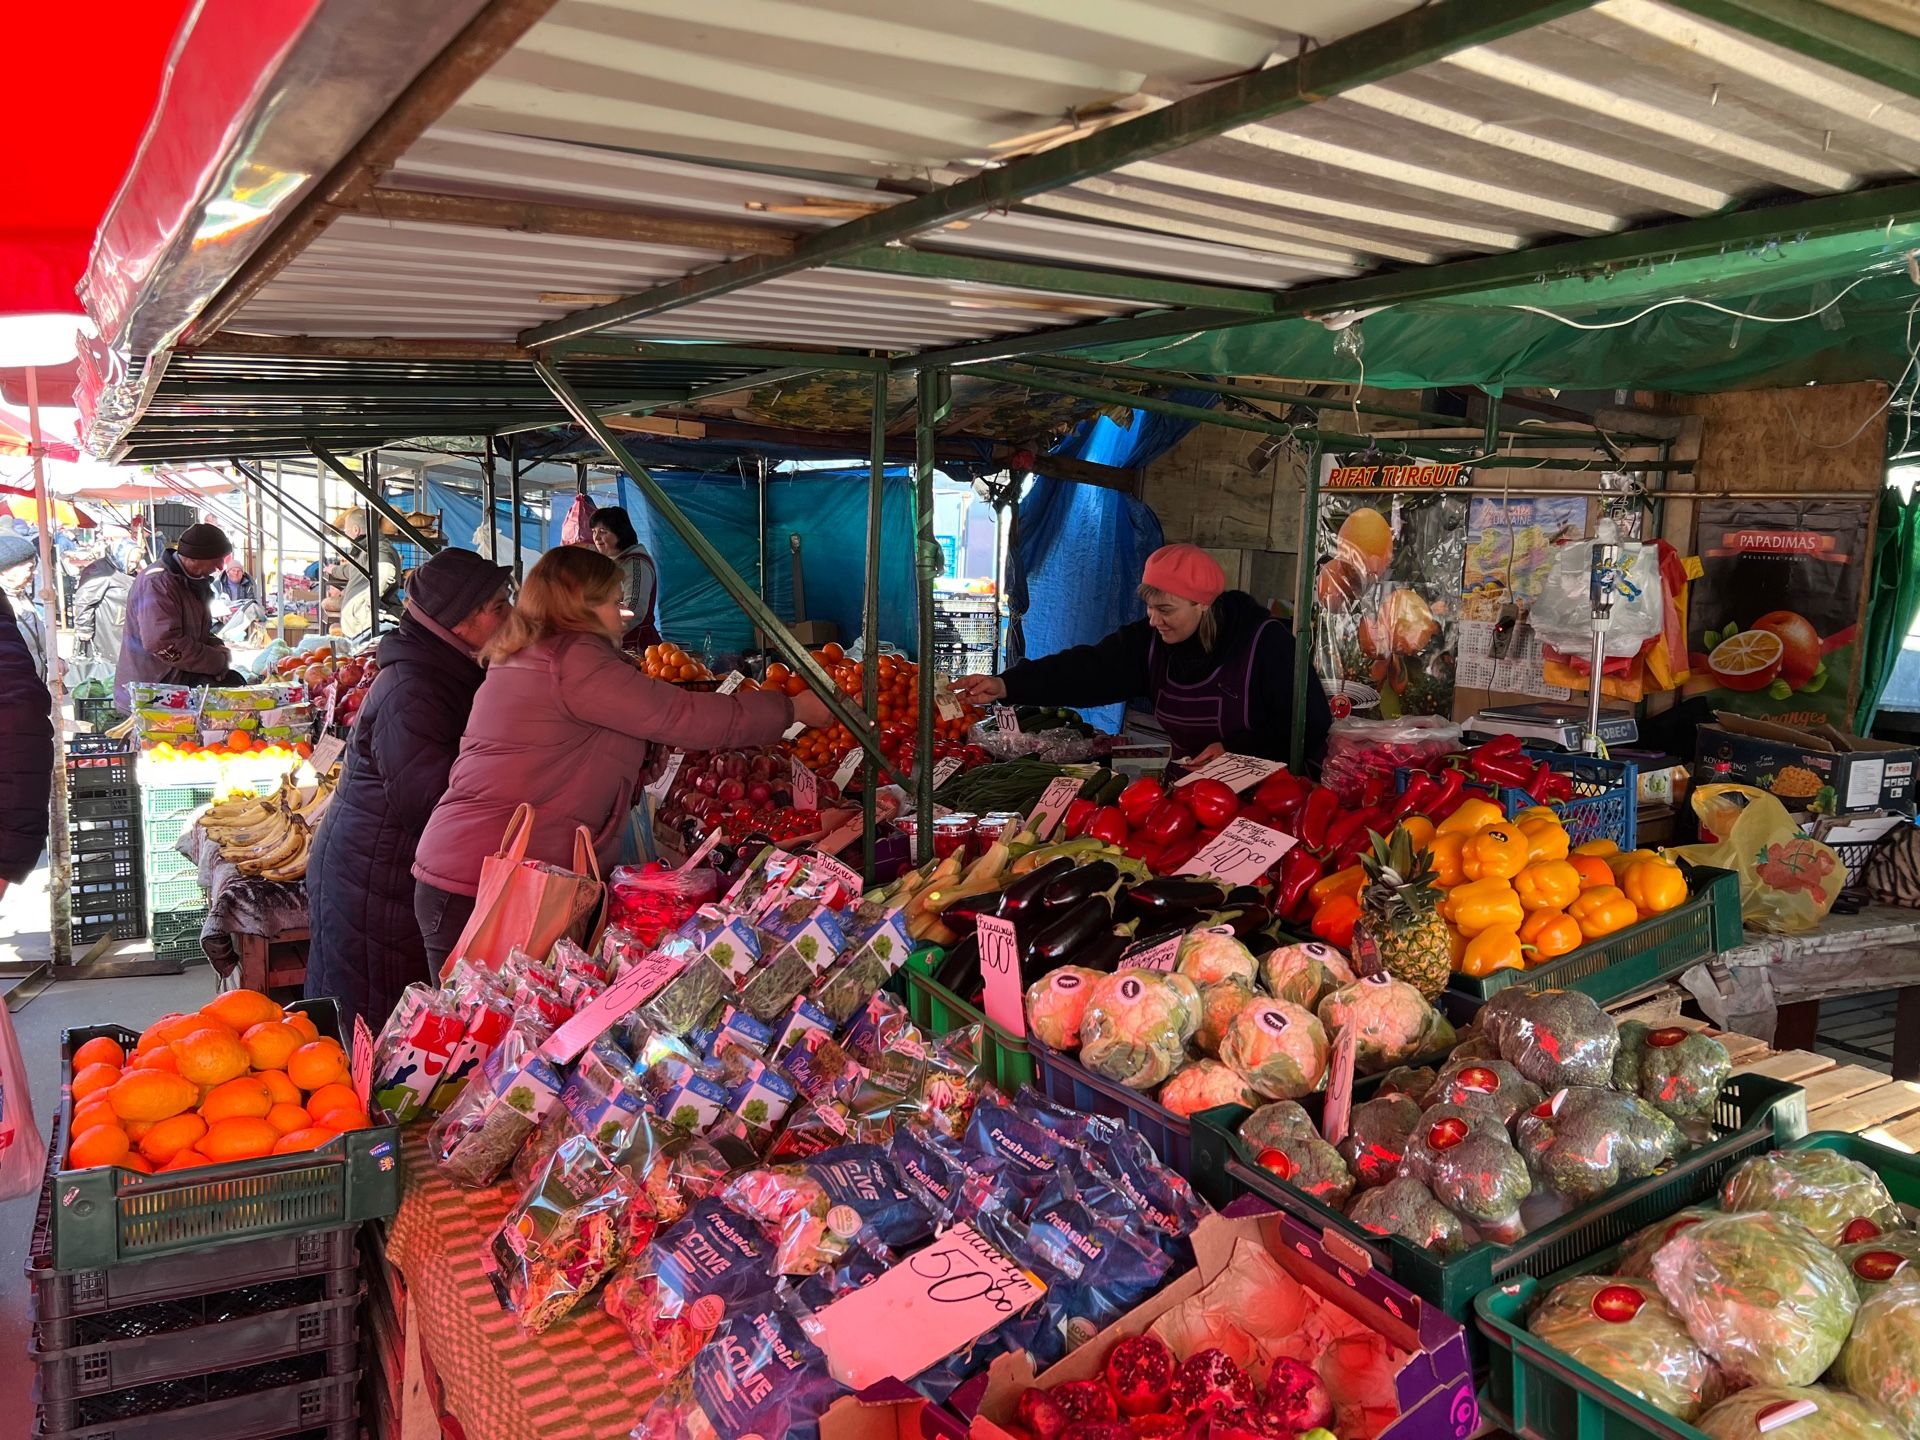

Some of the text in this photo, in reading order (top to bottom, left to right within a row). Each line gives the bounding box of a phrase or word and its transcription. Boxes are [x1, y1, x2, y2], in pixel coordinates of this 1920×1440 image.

[1328, 464, 1463, 487] RIFAT TURGUT
[1739, 535, 1816, 549] PAPADIMAS
[701, 1298, 720, 1321] 100%
[719, 1334, 774, 1405] ACTIVE
